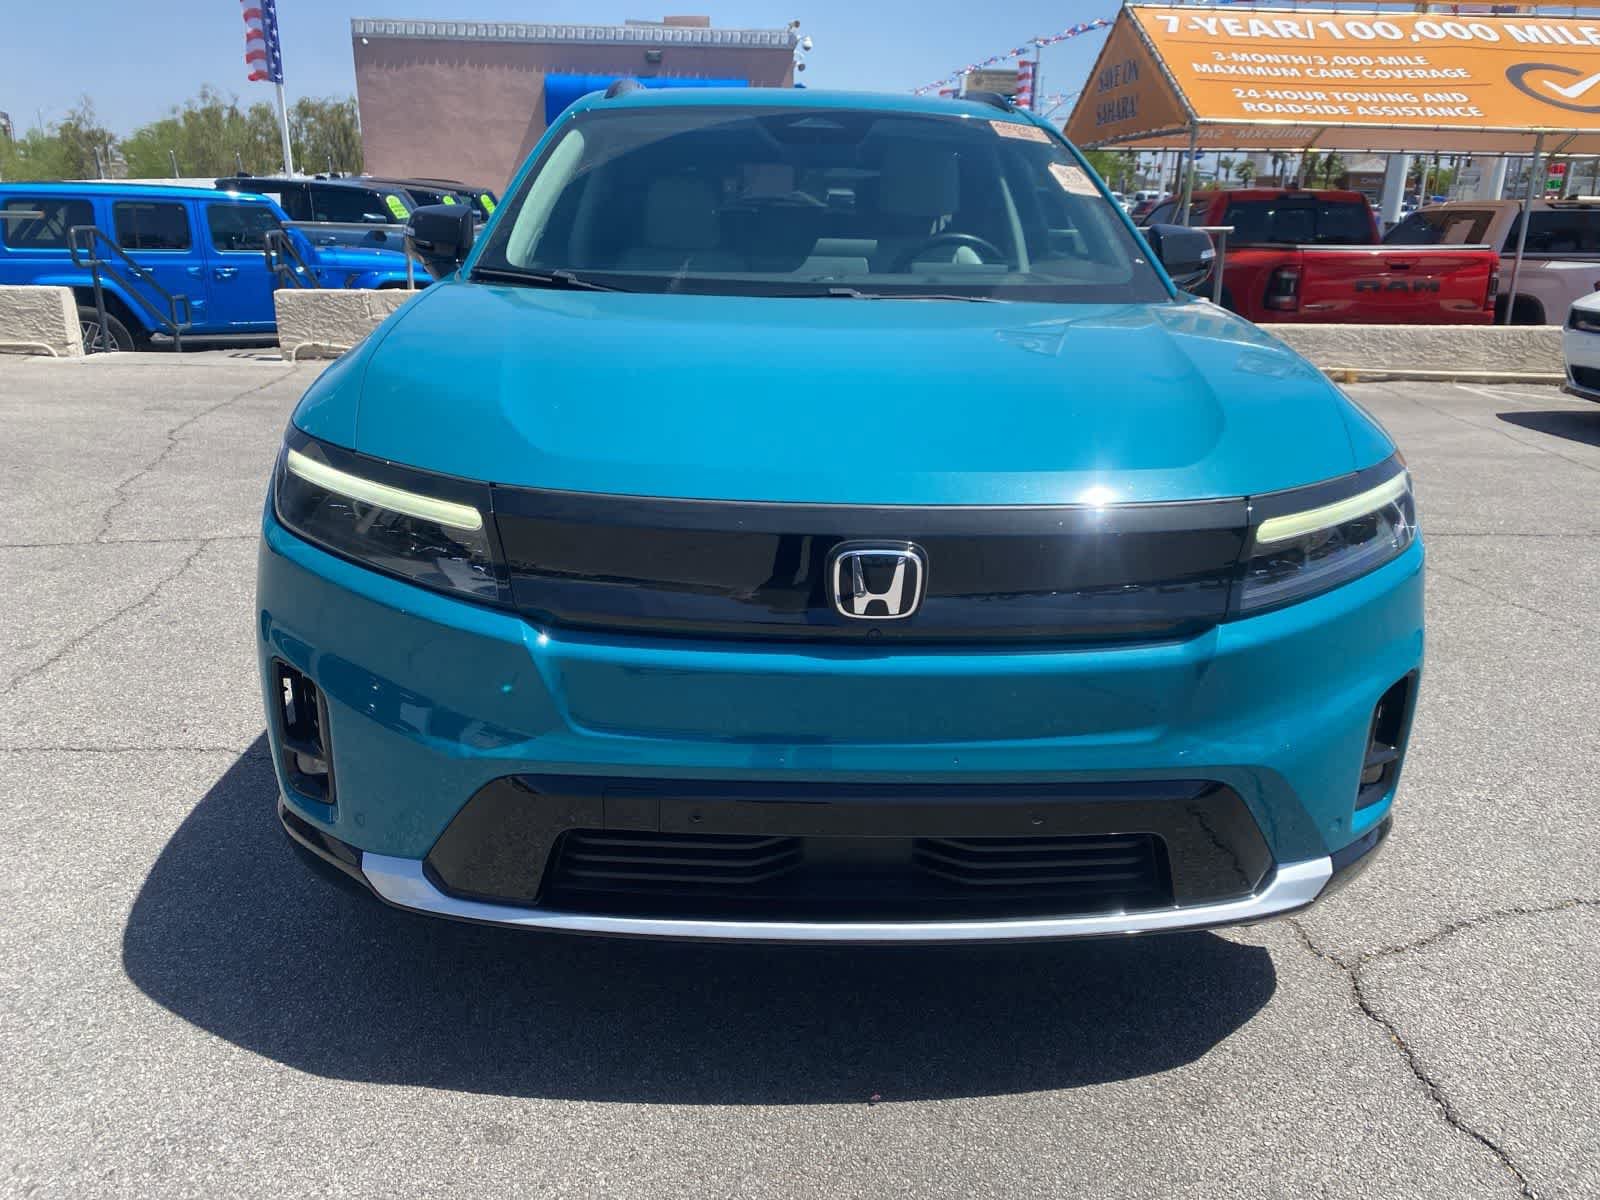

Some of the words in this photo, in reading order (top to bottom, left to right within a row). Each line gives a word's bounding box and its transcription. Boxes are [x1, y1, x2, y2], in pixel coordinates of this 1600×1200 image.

[1155, 15, 1500, 43] 7-YEAR/100,000
[1211, 51, 1429, 66] 3-MONTH/3,000-MILE
[1192, 63, 1301, 78] MAXIMUM
[1305, 68, 1359, 80] CARE
[1362, 68, 1472, 80] COVERAGE
[1232, 88, 1328, 102] 24-HOUR
[1330, 91, 1419, 104] TOWING
[1423, 92, 1469, 104] AND
[1242, 102, 1353, 116] ROADSIDE
[1357, 106, 1485, 118] ASSISTANCE
[1355, 280, 1440, 292] RAM
